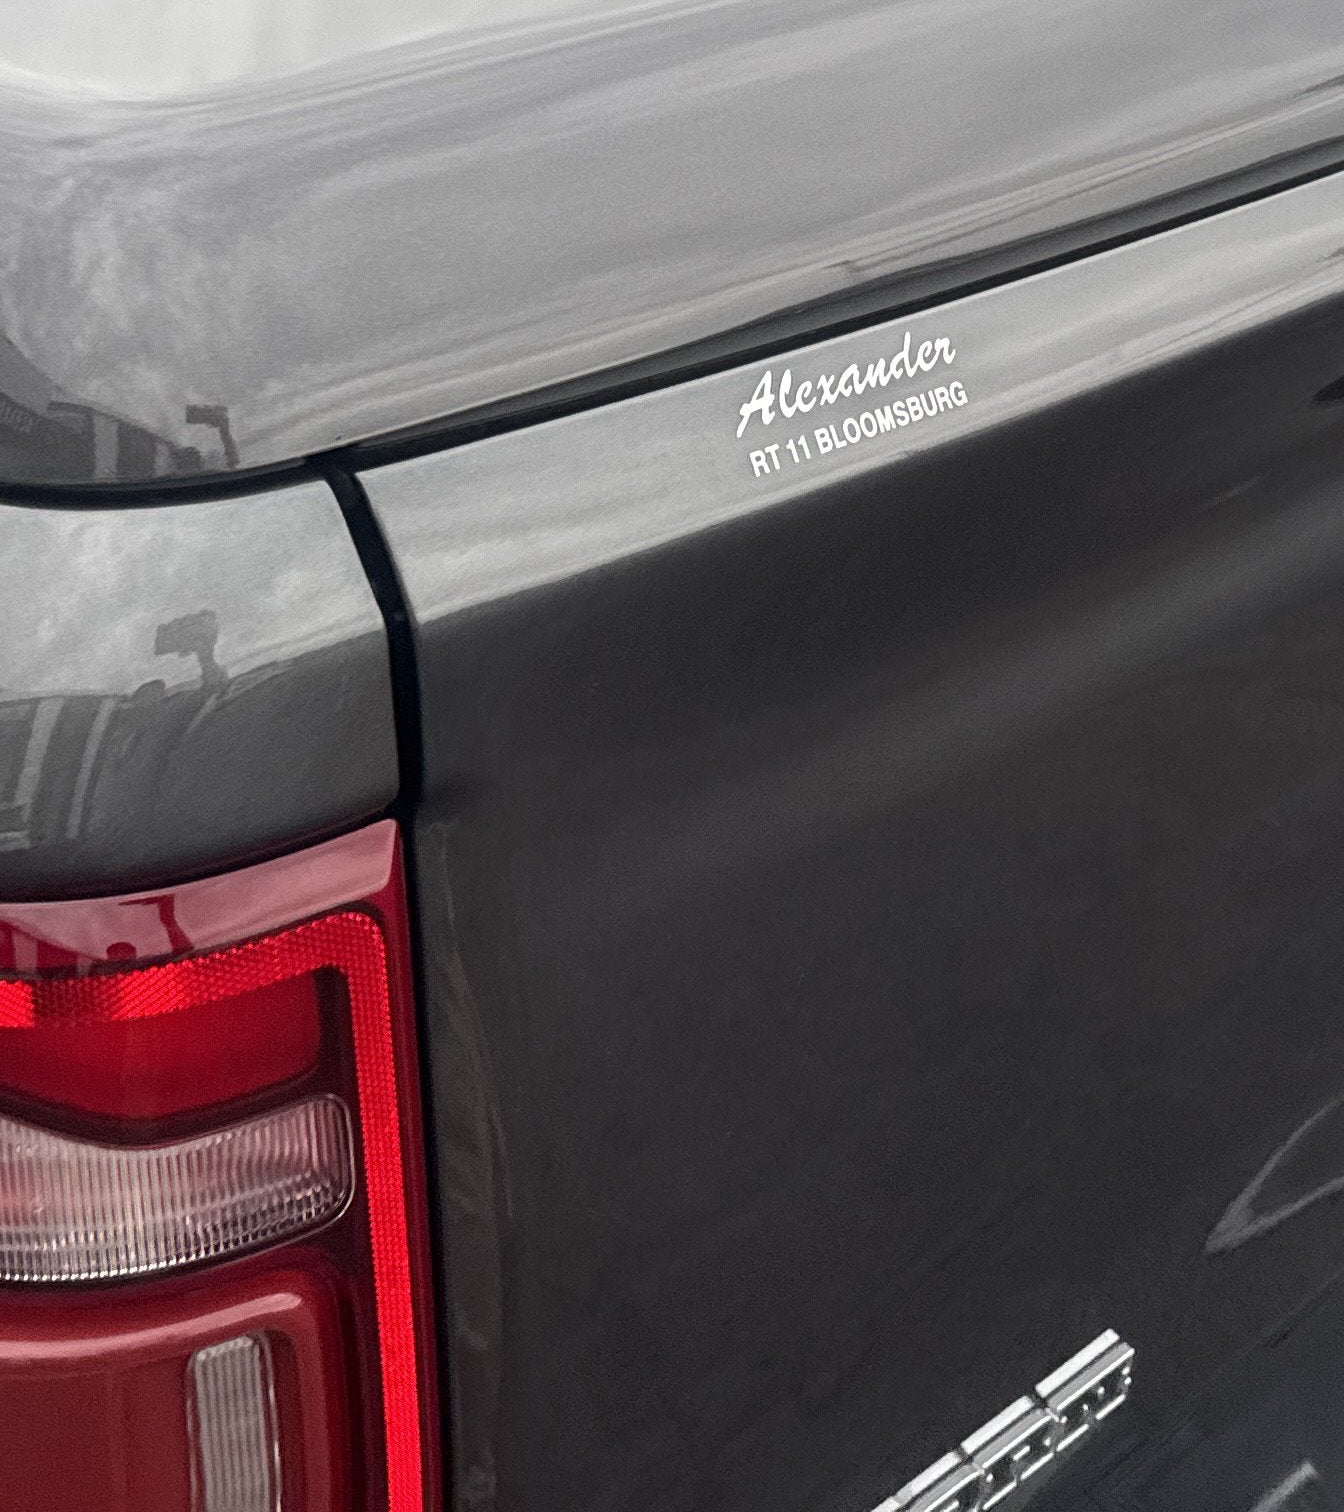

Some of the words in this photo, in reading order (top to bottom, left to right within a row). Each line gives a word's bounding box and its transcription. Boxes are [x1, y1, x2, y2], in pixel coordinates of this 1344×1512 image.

[737, 333, 956, 438] Alexander
[750, 444, 781, 477] RT
[787, 436, 812, 463] 11
[814, 382, 968, 454] BLOOMSBURG
